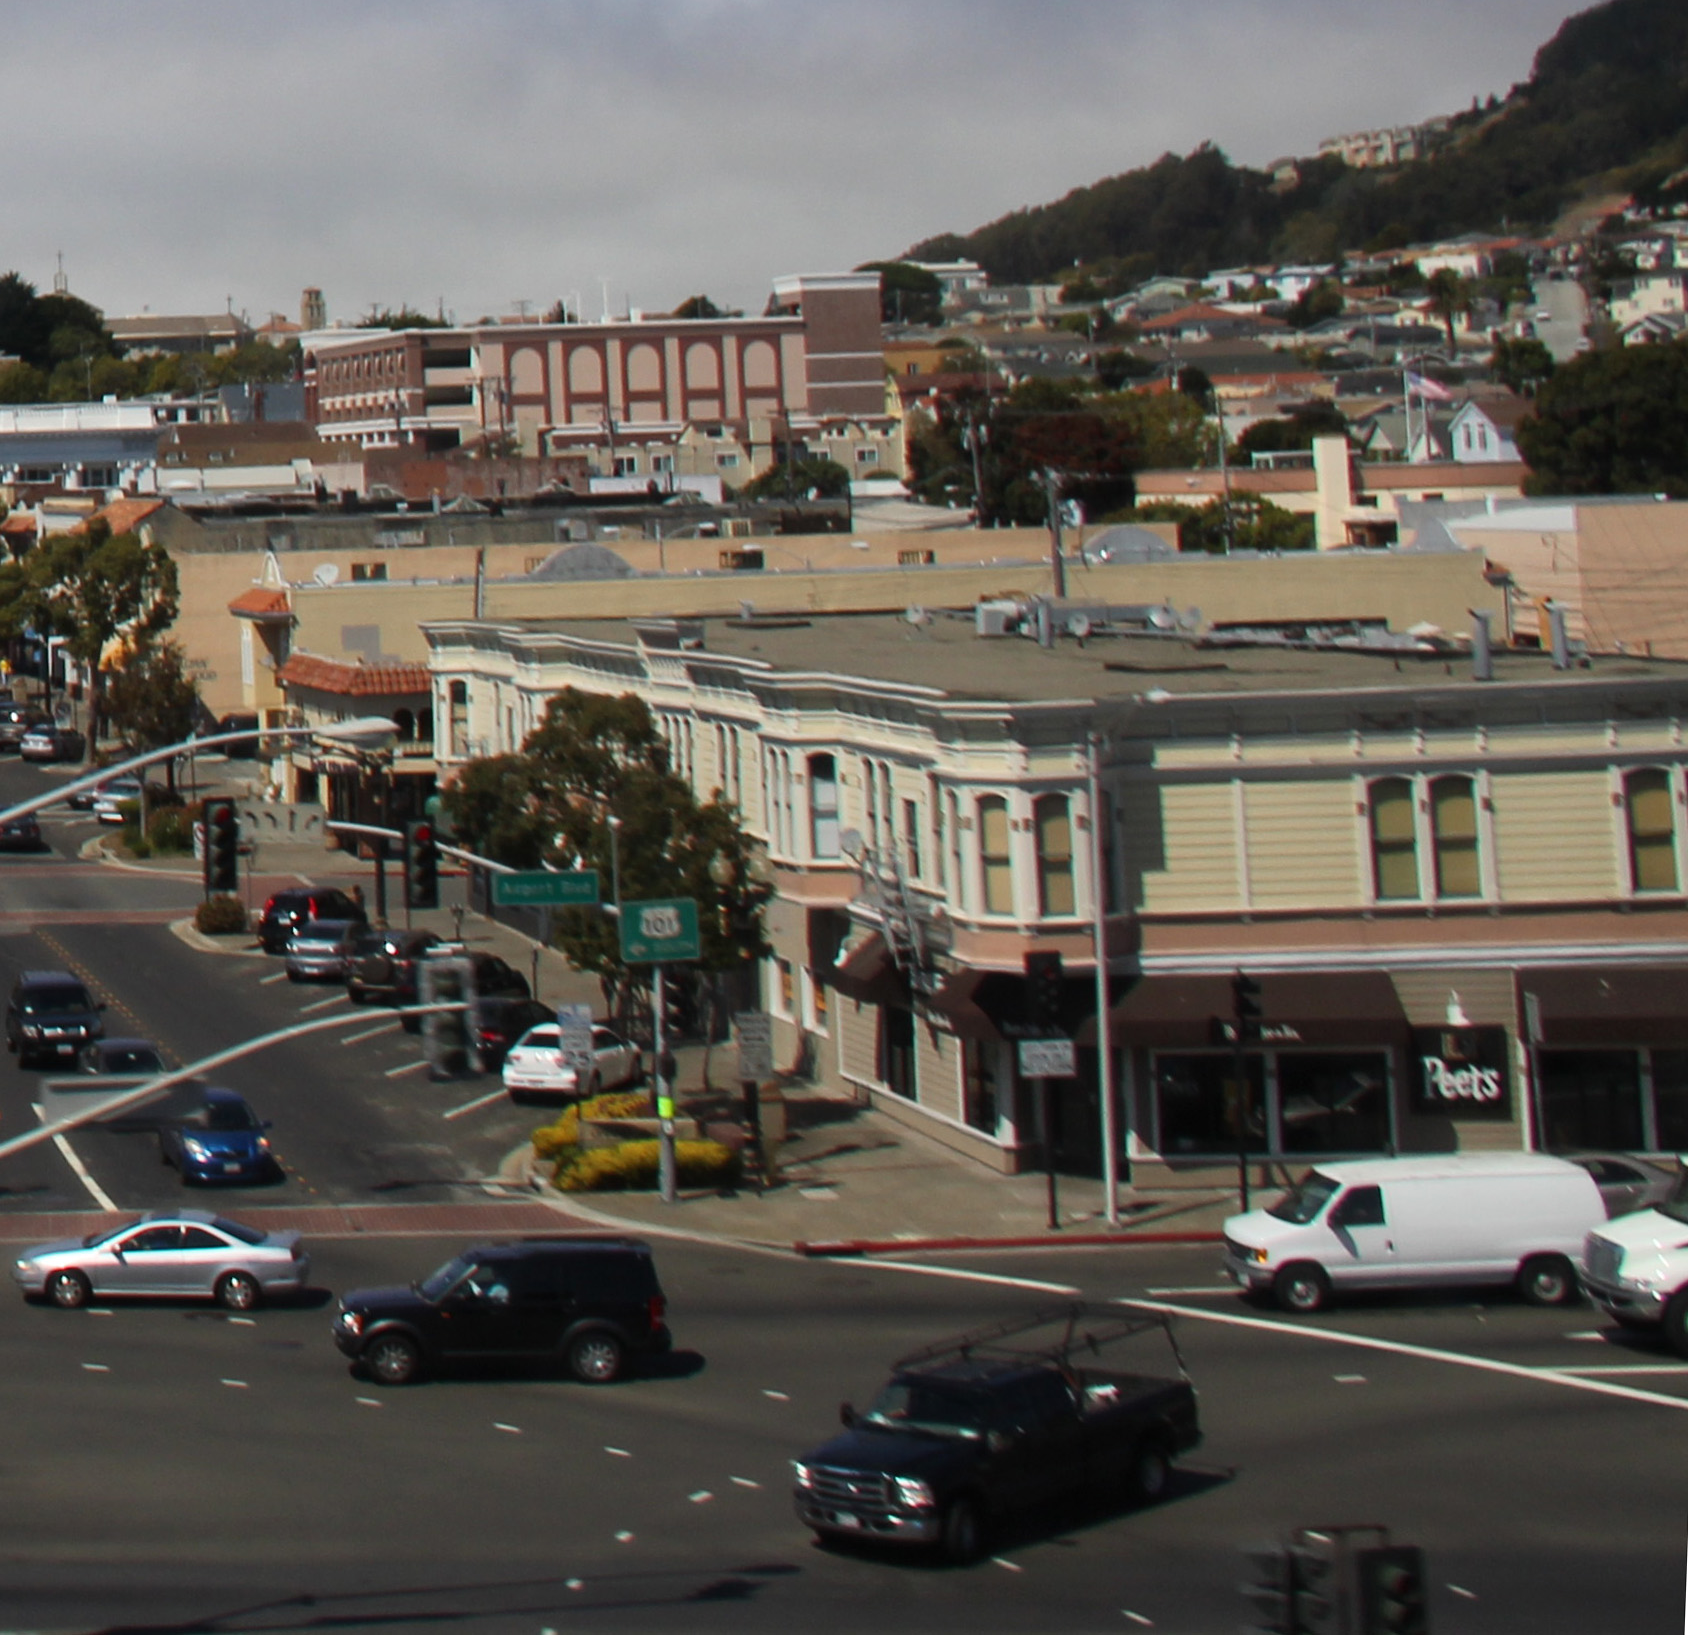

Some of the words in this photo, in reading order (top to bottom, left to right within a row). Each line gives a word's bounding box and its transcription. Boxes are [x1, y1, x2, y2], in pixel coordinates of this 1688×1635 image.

[501, 881, 554, 898] Airport
[644, 916, 675, 934] 101
[1422, 1056, 1501, 1101] Peet's
